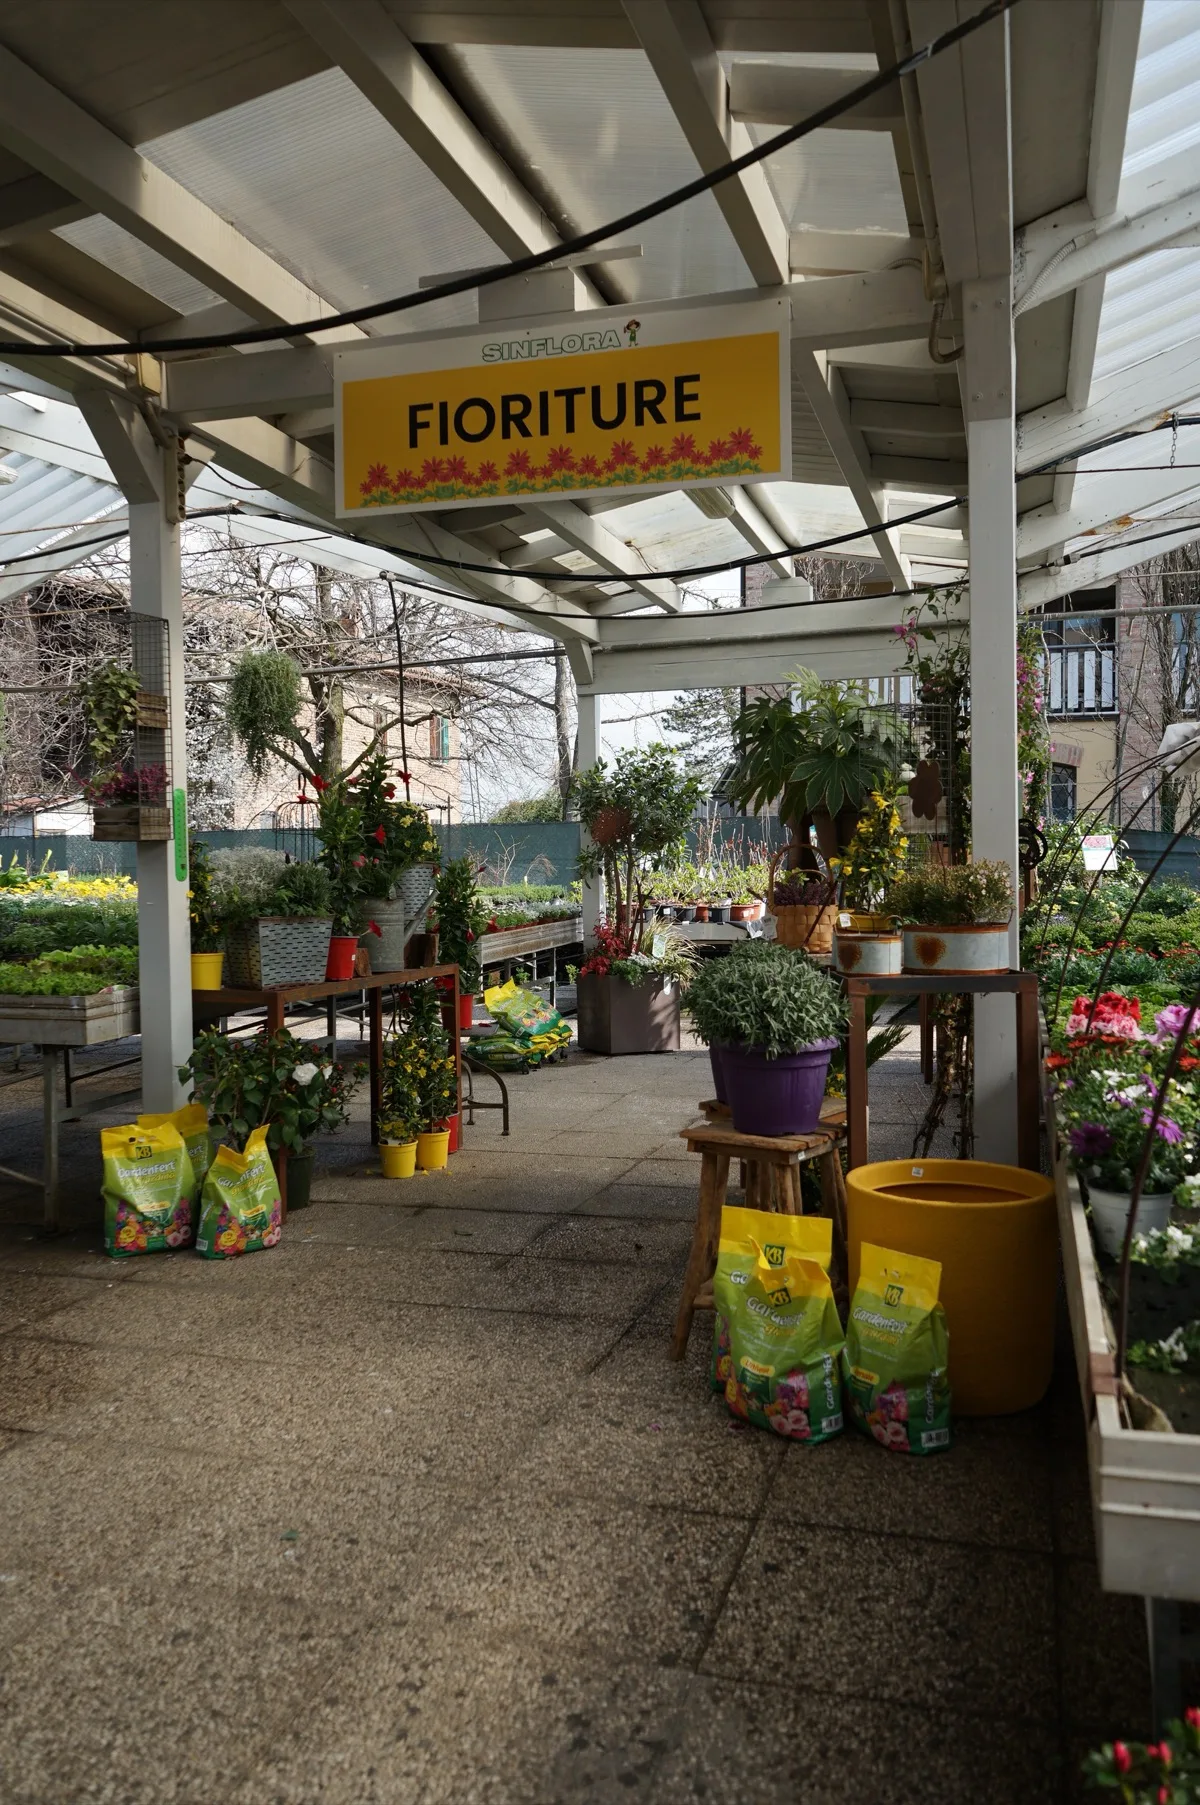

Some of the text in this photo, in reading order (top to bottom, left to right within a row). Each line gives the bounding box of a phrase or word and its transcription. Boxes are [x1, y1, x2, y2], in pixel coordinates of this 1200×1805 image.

[482, 330, 622, 362] SINFLORA
[407, 374, 702, 449] FIORITURE
[135, 1146, 151, 1159] KB
[765, 1246, 784, 1264] KB
[769, 1288, 790, 1307] KB
[885, 1286, 901, 1308] KB
